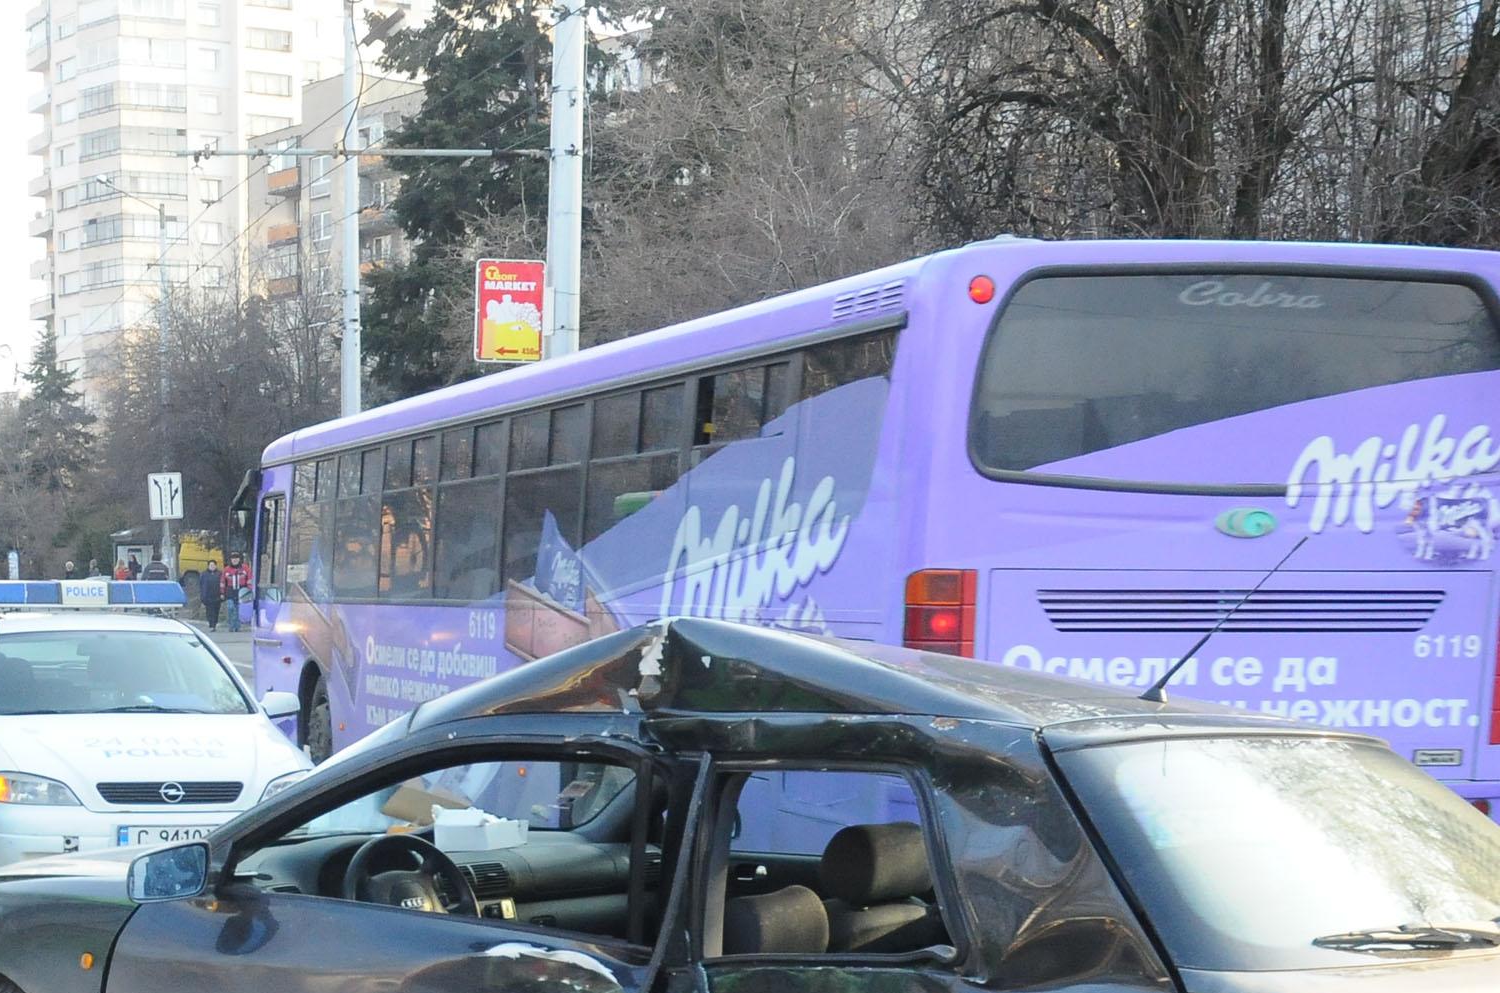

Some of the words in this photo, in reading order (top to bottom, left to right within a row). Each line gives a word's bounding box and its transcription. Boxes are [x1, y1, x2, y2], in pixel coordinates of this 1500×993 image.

[484, 280, 537, 292] MARKET
[1178, 280, 1325, 308] Cobra
[1286, 413, 1500, 534] Milka
[660, 455, 850, 621] Milka
[66, 586, 105, 597] POLICE
[468, 610, 496, 640] 6119
[366, 635, 405, 668] Осмели
[407, 647, 419, 670] се
[419, 650, 435, 677] да
[437, 641, 497, 680] добавиш
[1414, 634, 1482, 658] 6119
[1002, 644, 1198, 686] Осмели
[1211, 656, 1263, 686] се
[1273, 656, 1338, 692] да
[366, 674, 399, 698] малко
[1260, 698, 1480, 728] нежност.
[102, 748, 229, 759] POLICE
